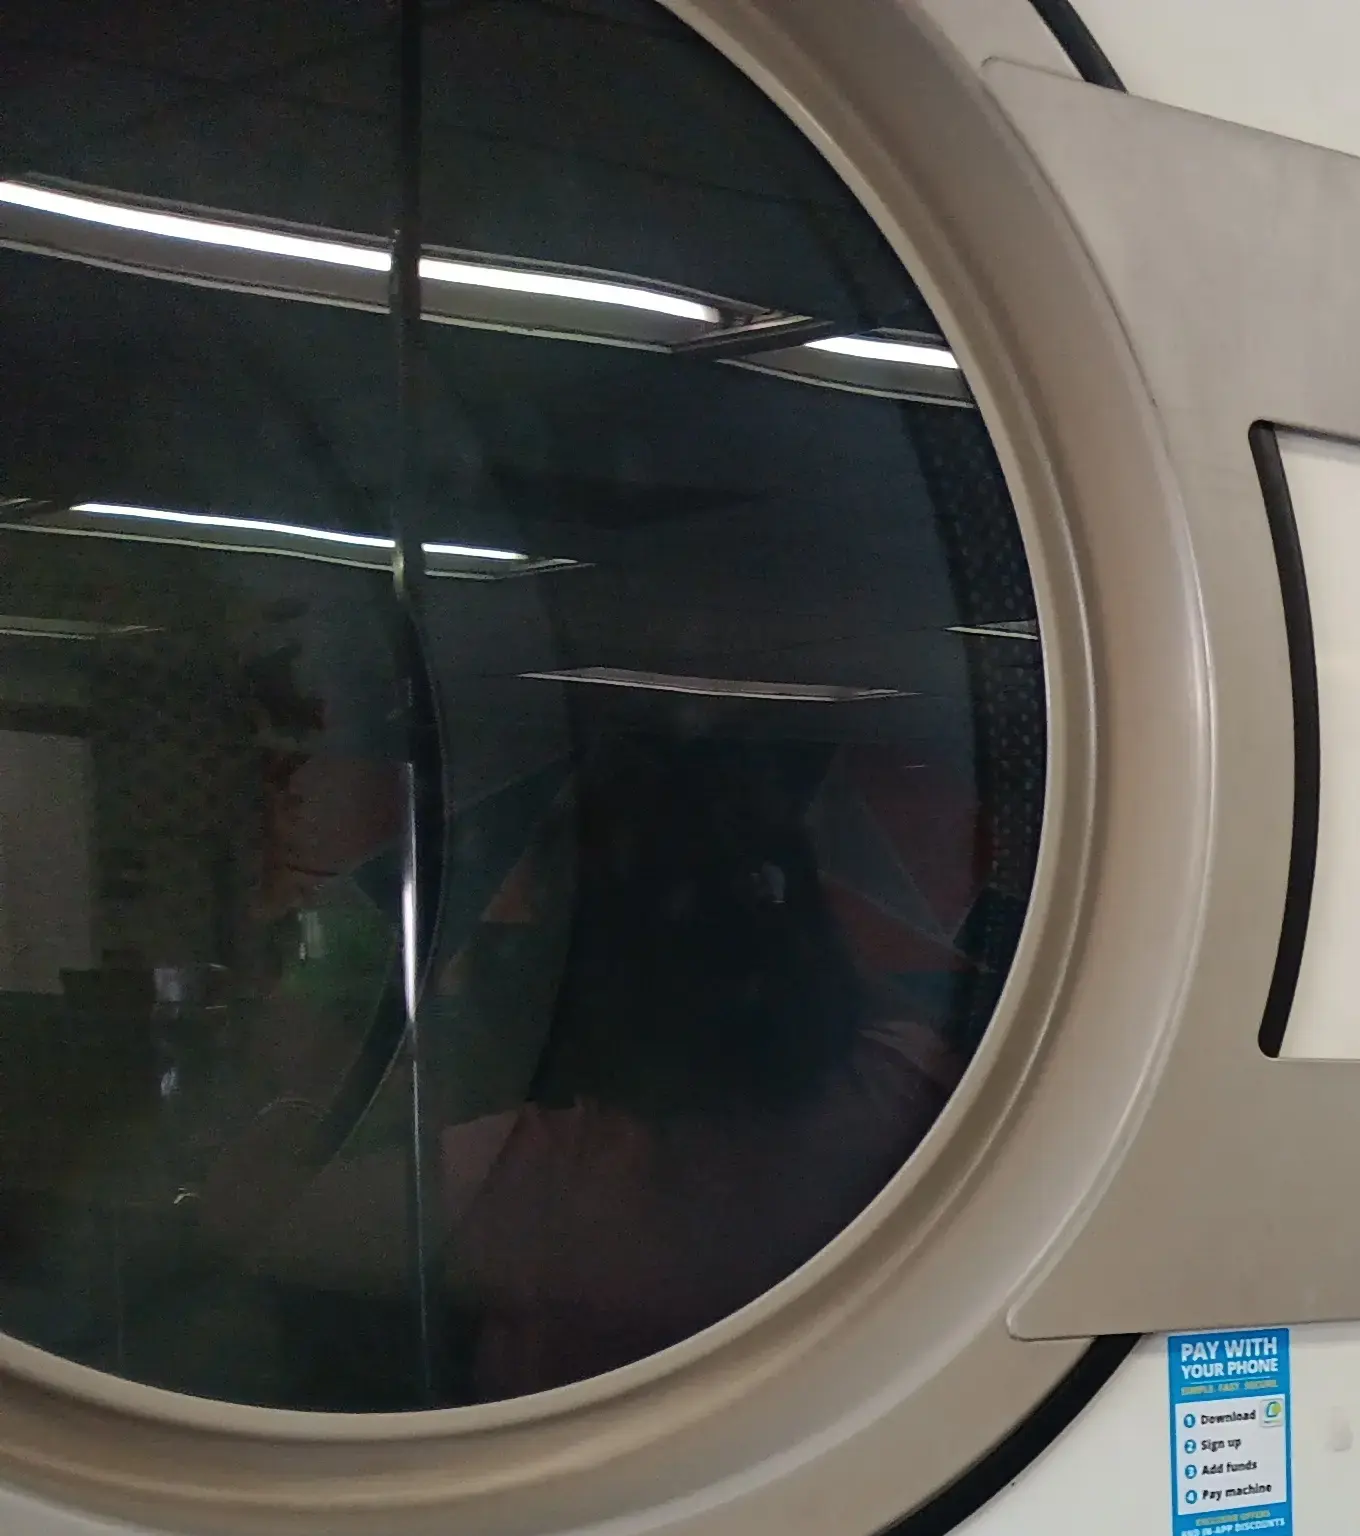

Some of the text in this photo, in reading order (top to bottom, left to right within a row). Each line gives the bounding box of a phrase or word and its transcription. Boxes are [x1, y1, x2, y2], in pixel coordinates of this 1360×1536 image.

[1181, 1337, 1278, 1362] PAY WITH
[1181, 1358, 1278, 1380] YOUR PHONE
[1201, 1410, 1256, 1425] Download
[1201, 1439, 1225, 1452] Sign
[1228, 1438, 1242, 1450] up
[1202, 1463, 1223, 1476] Add
[1226, 1460, 1258, 1473] funds
[1202, 1489, 1222, 1501] Pay
[1225, 1483, 1272, 1497] machine
